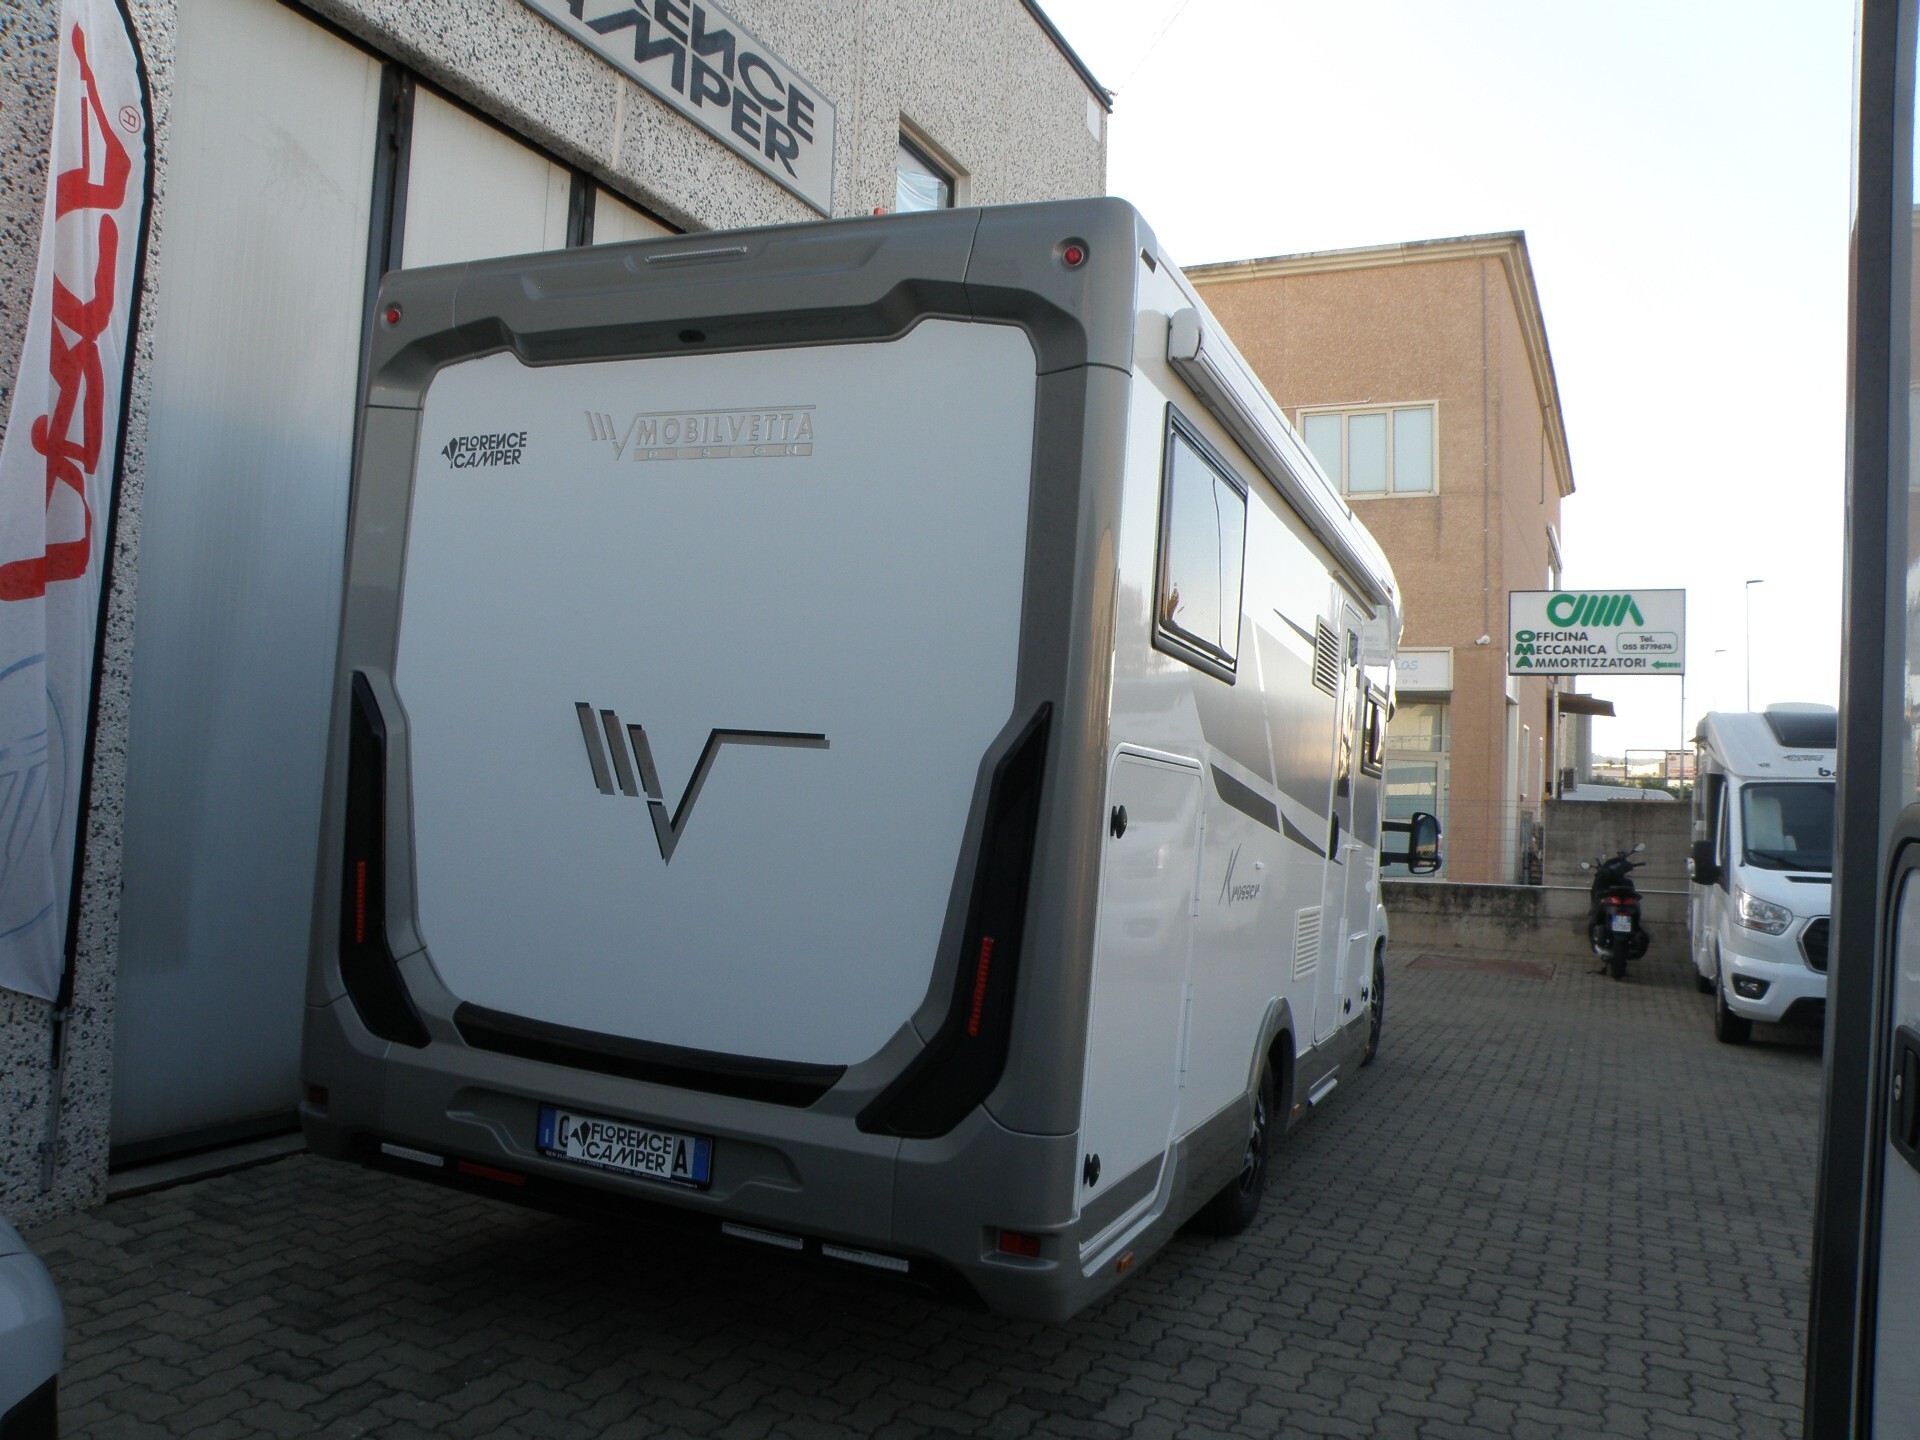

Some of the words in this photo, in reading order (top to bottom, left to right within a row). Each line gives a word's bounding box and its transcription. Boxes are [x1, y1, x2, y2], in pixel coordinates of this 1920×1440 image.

[634, 0, 815, 145] ENCE
[634, 413, 814, 446] MOBILVETTA
[458, 431, 528, 453] FLORENCE
[453, 448, 522, 469] CAMPER
[1515, 630, 1589, 643] OFFICINA
[1639, 635, 1656, 643] Tel.
[1514, 643, 1607, 656] MECCANICA
[1515, 656, 1646, 669] AMMORTIZZATORI
[591, 1122, 673, 1155] FLORENCE
[585, 1141, 666, 1173] CAMPER
